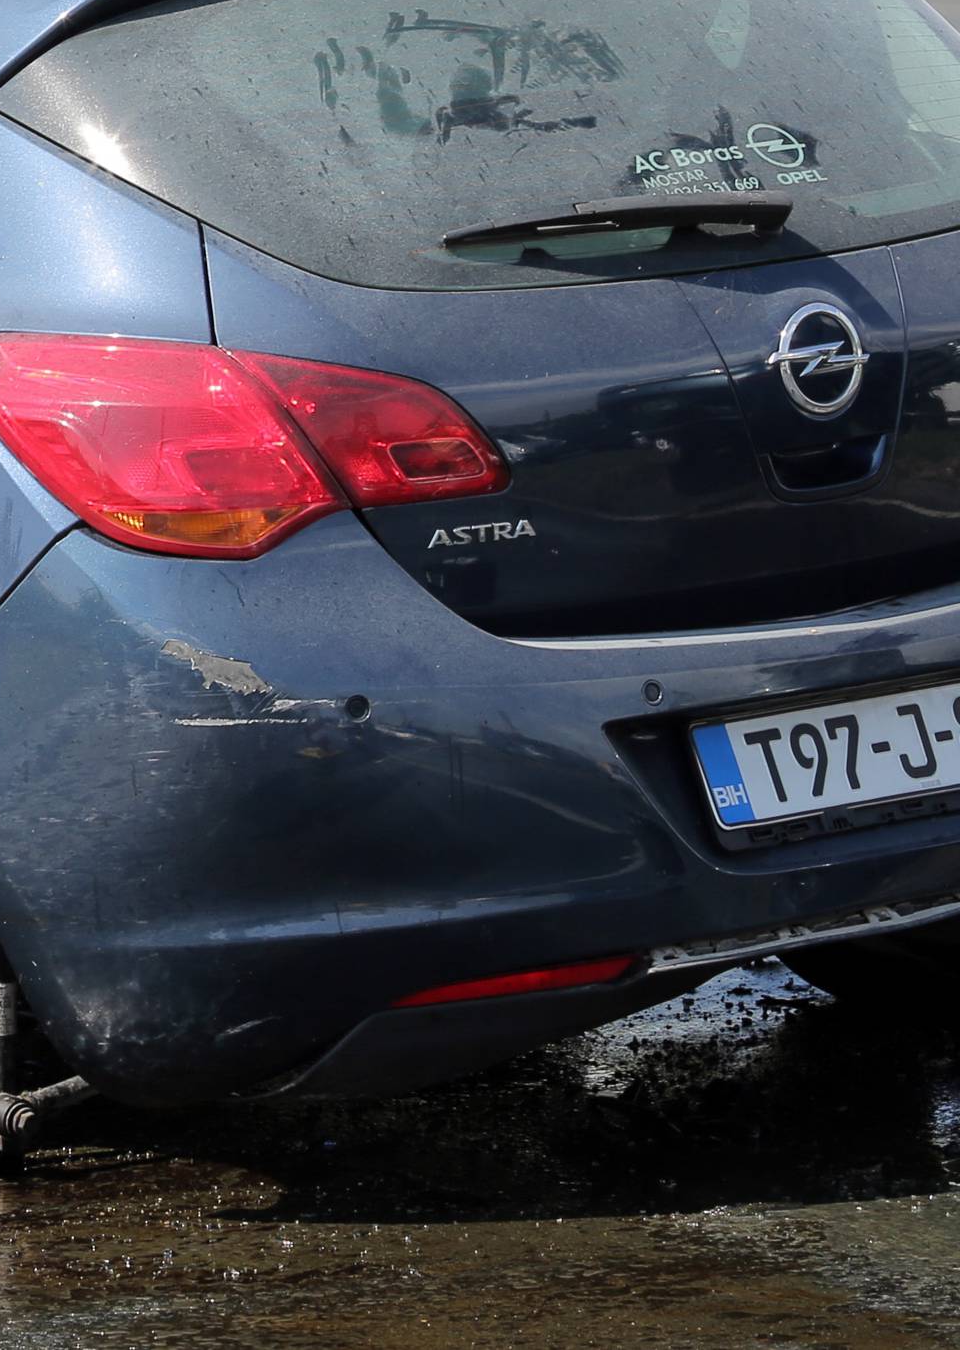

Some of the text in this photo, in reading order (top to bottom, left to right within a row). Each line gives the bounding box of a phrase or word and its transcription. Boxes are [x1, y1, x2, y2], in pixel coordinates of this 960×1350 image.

[634, 145, 743, 173] AC Boras
[642, 169, 708, 189] MOSTAR
[777, 169, 827, 185] OPEL
[427, 519, 537, 549] ASTRA
[743, 696, 960, 803] T97-J-
[712, 783, 749, 808] BIH
